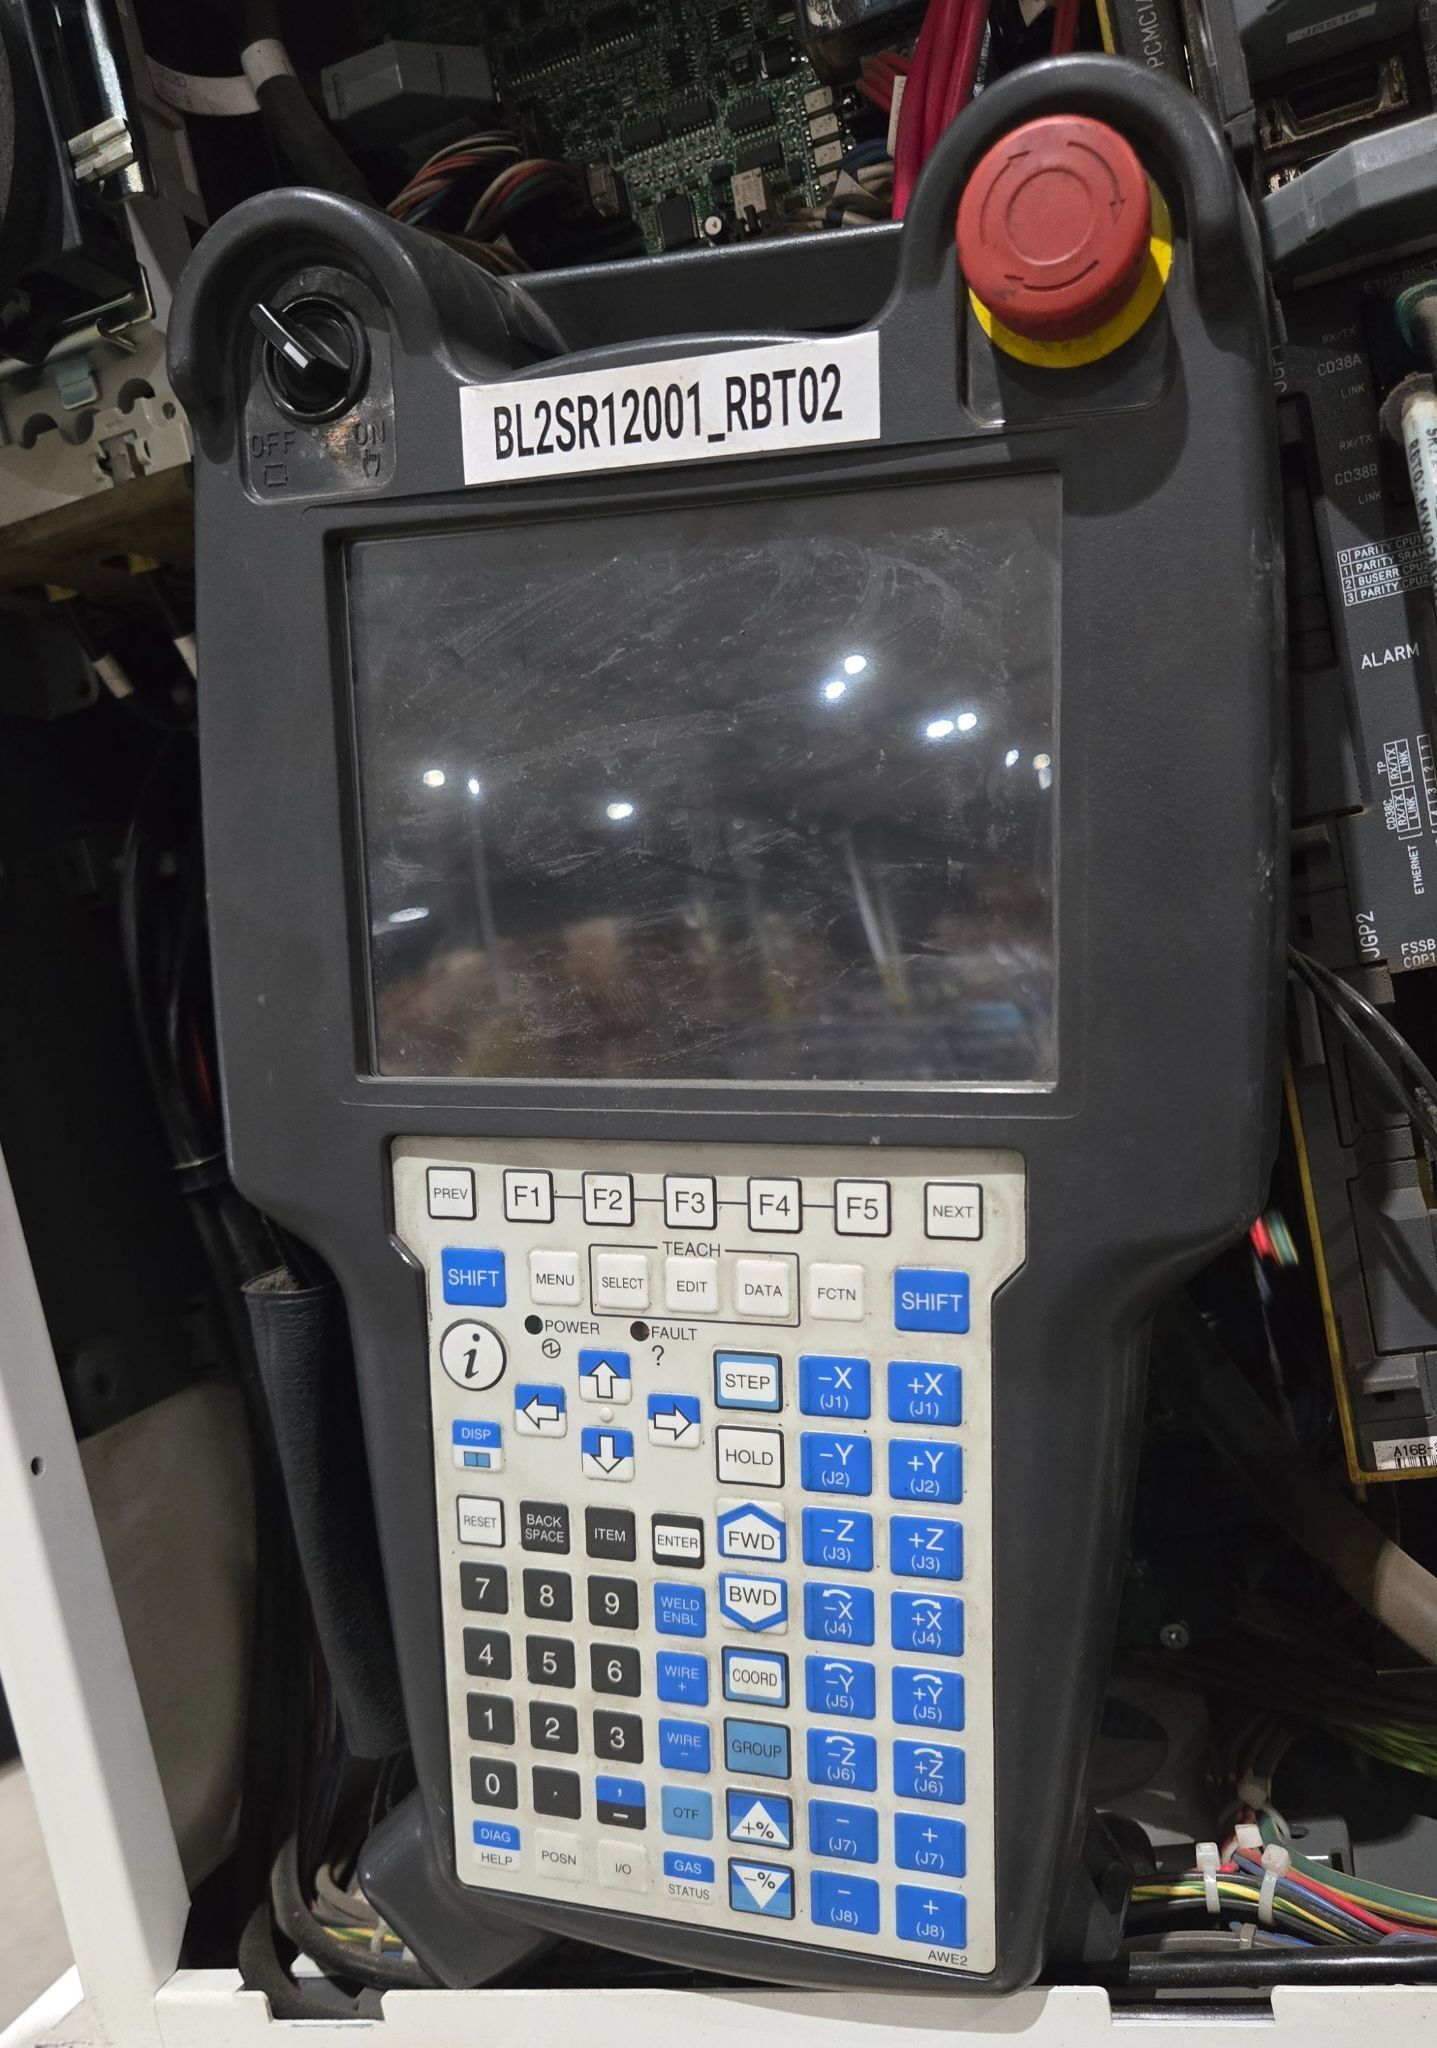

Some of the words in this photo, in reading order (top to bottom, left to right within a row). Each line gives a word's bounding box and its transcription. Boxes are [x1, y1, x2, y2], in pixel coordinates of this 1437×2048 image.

[1136, 0, 1164, 68] PCMCI
[1317, 353, 1363, 377] CD38A
[1341, 383, 1365, 399] LINK
[494, 364, 843, 461] BL2SR12001_RBT02
[355, 421, 386, 446] ON
[1339, 433, 1373, 451] RX/TX
[252, 430, 296, 458] OFF
[1335, 463, 1379, 486] CD38B
[1358, 490, 1383, 505] LINK
[1354, 541, 1394, 560] PARITY
[1395, 534, 1422, 549] CPU1
[1356, 553, 1395, 573] PARITY
[1398, 548, 1426, 562] SRAM
[1358, 568, 1400, 586] BUSERR
[1402, 560, 1429, 575] CPU2
[1360, 581, 1399, 600] PARITY
[1402, 574, 1429, 589] CPU2
[1361, 642, 1420, 670] ALARM
[1377, 762, 1387, 775] TP
[1387, 747, 1400, 780] RX/TX
[1399, 750, 1411, 774] LINK
[1383, 799, 1397, 830] CD38C
[1394, 794, 1408, 826] RX/TX
[1406, 797, 1418, 820] LINK
[1407, 845, 1425, 894] ETHERNET
[1356, 910, 1381, 958] JGP2
[1401, 938, 1437, 956] FSSB
[433, 1187, 468, 1200] PREV
[514, 1185, 539, 1208] F1
[592, 1188, 624, 1211] F2
[674, 1191, 706, 1214] F3
[759, 1193, 791, 1217] F4
[845, 1196, 879, 1221] F5
[932, 1205, 974, 1219] NEXT
[662, 1241, 721, 1257] TEACH
[447, 1268, 500, 1288] SHIFT
[535, 1273, 575, 1287] MENU
[601, 1276, 644, 1290] SELECT
[676, 1280, 708, 1293] EDIT
[744, 1283, 783, 1298] DATA
[816, 1287, 857, 1302] FCTN
[901, 1291, 963, 1313] SHIFT
[544, 1319, 600, 1335] POWER
[651, 1326, 698, 1341] FAULT
[725, 1373, 771, 1390] STEP
[817, 1366, 853, 1390] -X
[907, 1371, 944, 1397] +X
[819, 1394, 849, 1413] (J1)
[909, 1401, 940, 1419] (J1)
[461, 1427, 492, 1441] DISP
[725, 1448, 774, 1467] HOLD
[819, 1442, 855, 1466] -Y
[907, 1449, 944, 1475] +Y
[821, 1470, 850, 1488] (J2)
[909, 1478, 940, 1497] (J2)
[463, 1514, 497, 1529] RESET
[526, 1513, 562, 1528] BACK
[525, 1527, 565, 1543] SPACE
[594, 1527, 626, 1543] ITEM
[728, 1530, 775, 1551] FWD
[820, 1519, 855, 1543] -Z
[908, 1527, 945, 1552] +Z
[657, 1534, 699, 1549] ENTER
[822, 1545, 851, 1563] (J3)
[911, 1554, 941, 1573] (J3)
[474, 1576, 491, 1601] 7
[539, 1583, 555, 1609] 8
[729, 1585, 777, 1607] BWD
[604, 1591, 620, 1616] 9
[660, 1594, 700, 1612] WELD
[824, 1600, 854, 1621] -X
[662, 1610, 698, 1627] ENBL
[911, 1609, 942, 1631] +X
[824, 1620, 853, 1639] (J4)
[912, 1630, 942, 1649] (J4)
[478, 1642, 494, 1667] 4
[541, 1651, 557, 1675] 5
[606, 1659, 623, 1684] 6
[665, 1664, 700, 1681] WIRE
[731, 1667, 778, 1688] COORD
[825, 1673, 855, 1694] -Y
[825, 1693, 855, 1712] (J5)
[912, 1684, 943, 1706] +Y
[483, 1707, 494, 1733] 1
[912, 1705, 943, 1724] (J5)
[544, 1716, 560, 1741] 2
[609, 1725, 626, 1750] 3
[666, 1732, 702, 1749] WIRE
[731, 1739, 782, 1759] GROUP
[827, 1746, 856, 1767] -Z
[827, 1766, 856, 1785] (J6)
[914, 1758, 944, 1780] +Z
[484, 1772, 501, 1796] 0
[914, 1778, 943, 1797] (J6)
[672, 1806, 700, 1820] OTF
[480, 1827, 512, 1844] DIAG
[742, 1820, 775, 1840] +%
[828, 1837, 857, 1856] (J7)
[481, 1852, 514, 1867] HELP
[541, 1849, 577, 1866] POSN
[674, 1859, 702, 1875] GAS
[914, 1850, 945, 1869] (J7)
[614, 1862, 632, 1875] I/O
[743, 1870, 776, 1890] -%
[667, 1883, 711, 1901] STATUS
[830, 1907, 858, 1926] (J8)
[915, 1921, 945, 1940] (J8)
[927, 1949, 968, 1968] AWE2
